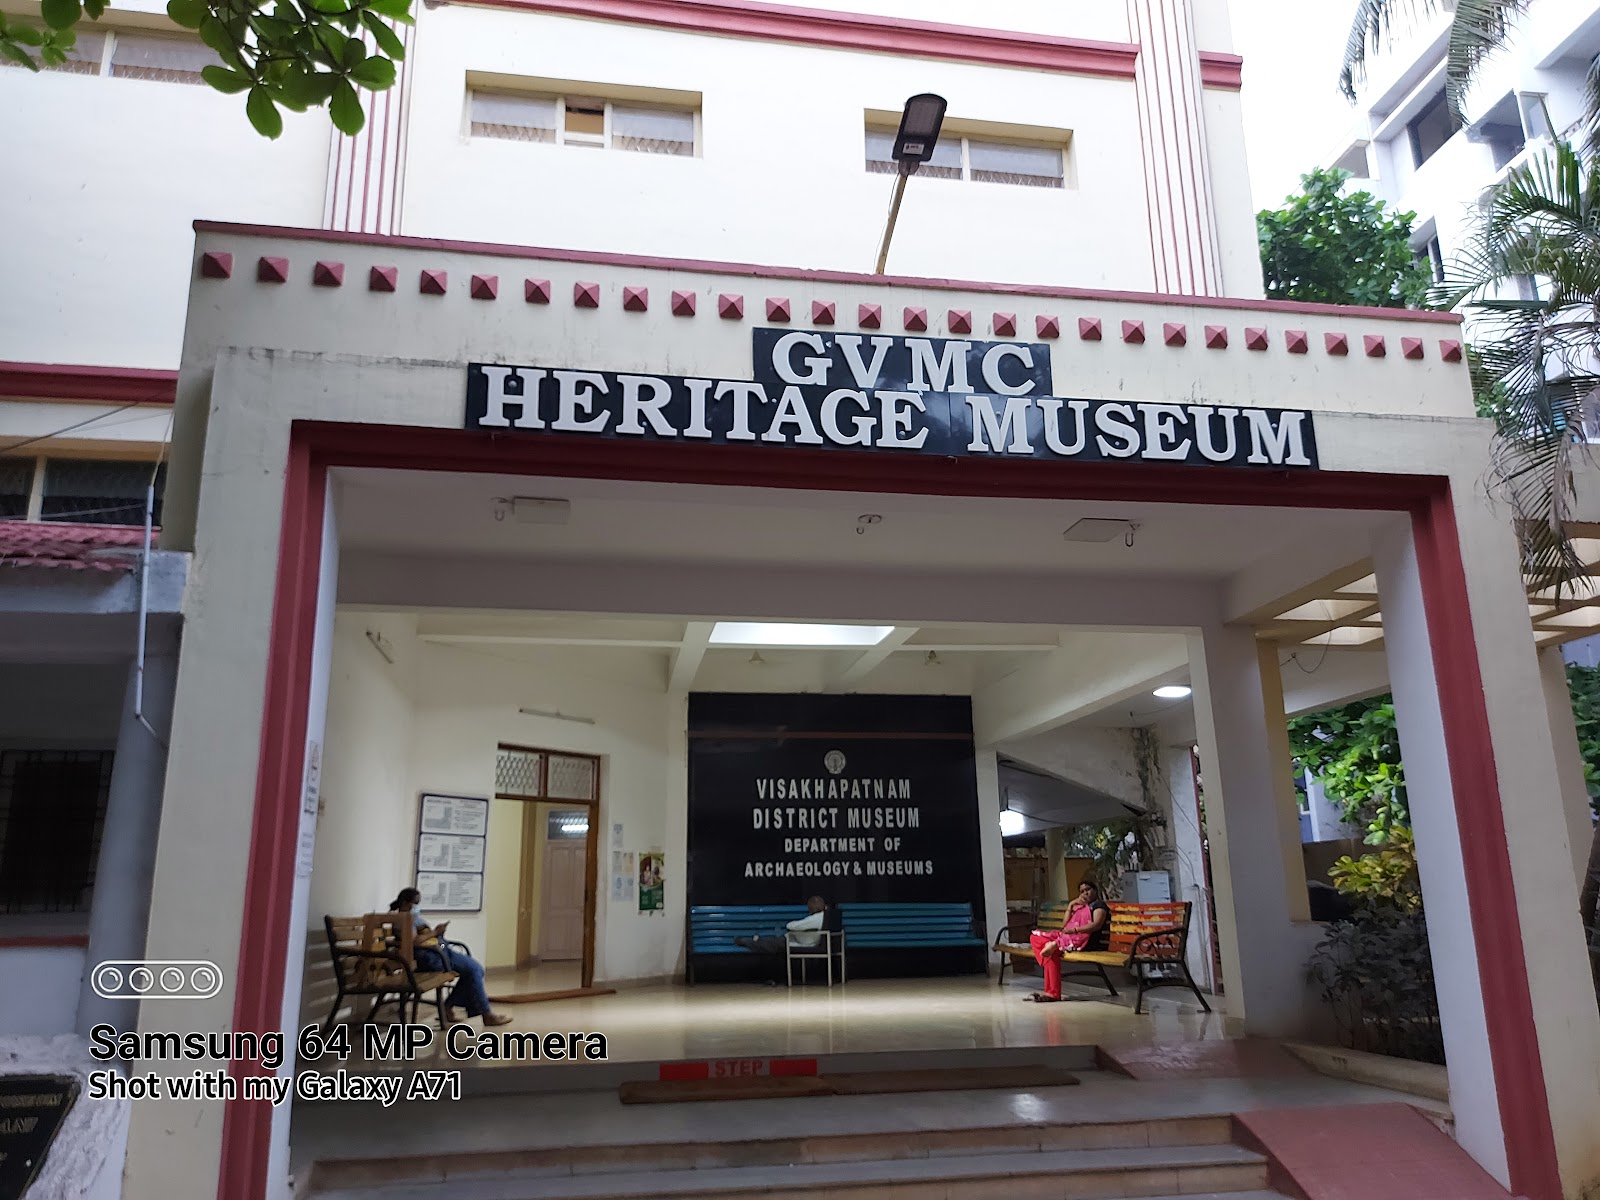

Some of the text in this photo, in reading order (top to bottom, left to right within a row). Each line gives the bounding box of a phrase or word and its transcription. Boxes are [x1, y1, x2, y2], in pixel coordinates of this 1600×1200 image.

[773, 332, 1036, 397] GVMC
[478, 365, 1312, 467] HERITAGE MUSEUM
[756, 778, 911, 799] VISAKHAPATNAM
[753, 808, 920, 829] DISTRICT MUSEUM
[784, 837, 901, 853] DEPARTMENT OF
[745, 861, 850, 877] ARCHAEOLOGY
[866, 860, 934, 875] MUSEUMS
[714, 1059, 763, 1077] STEP
